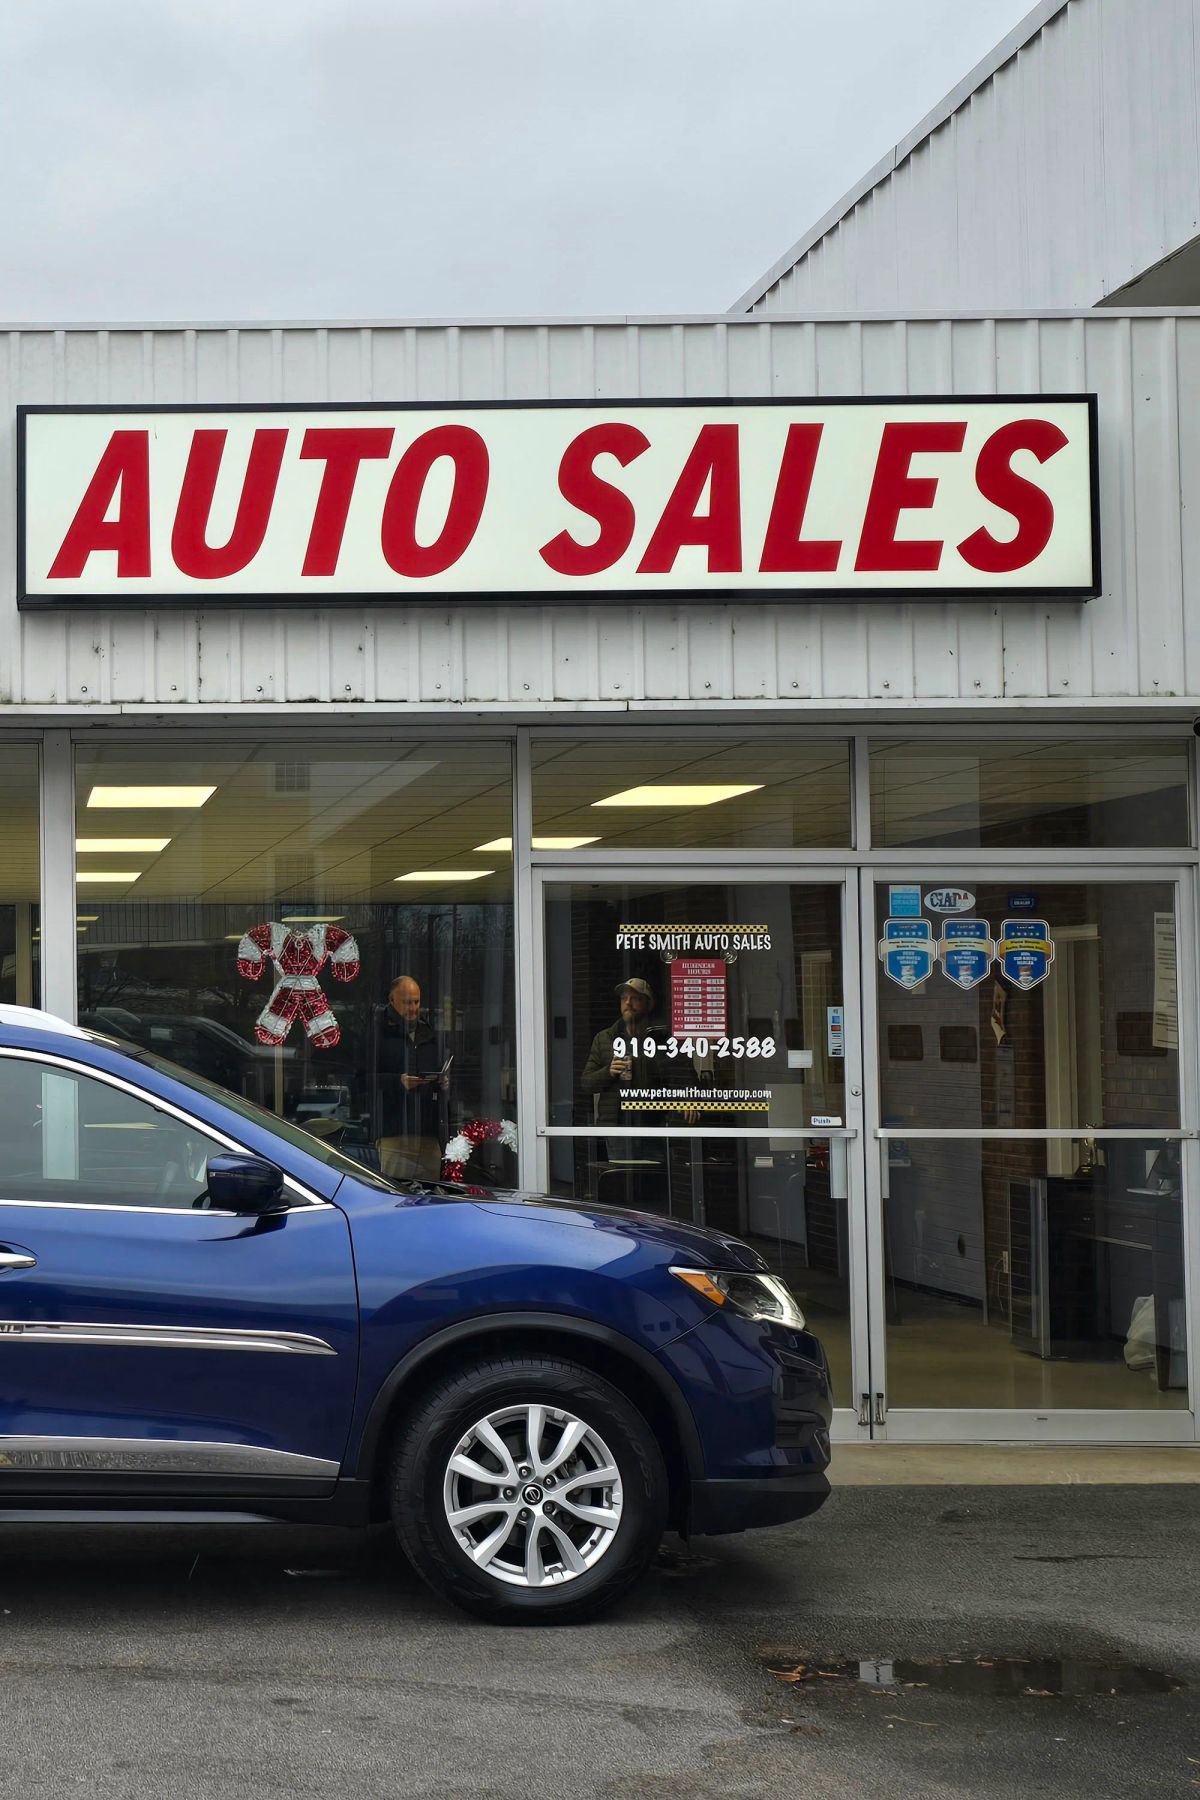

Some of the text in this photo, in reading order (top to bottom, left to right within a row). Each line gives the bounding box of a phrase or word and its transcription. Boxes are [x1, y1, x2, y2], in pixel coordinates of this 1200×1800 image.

[47, 419, 1069, 579] AUTO SALES
[616, 934, 772, 951] PETE SMITH AUTO SALES
[612, 1036, 777, 1059] 919-340-2588
[619, 1087, 772, 1101] www.petesmithautogroup.com
[813, 1117, 831, 1125] Push
